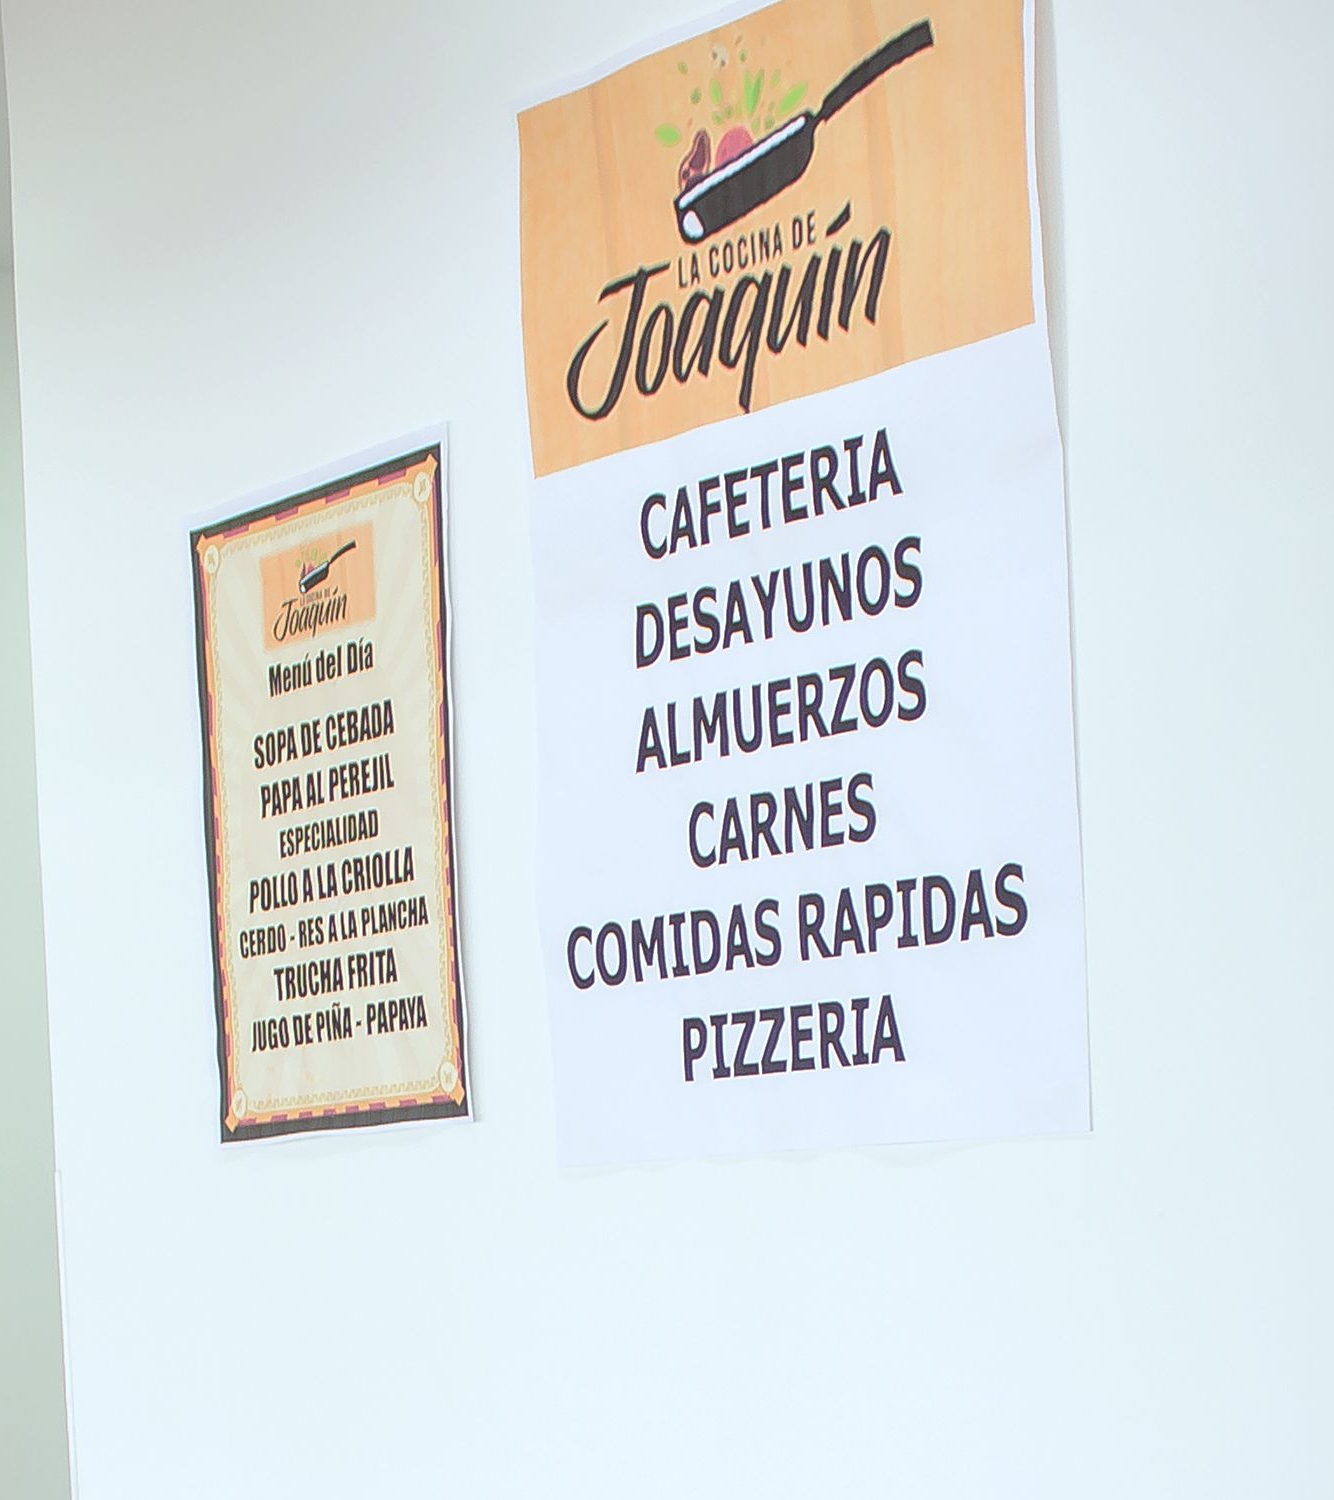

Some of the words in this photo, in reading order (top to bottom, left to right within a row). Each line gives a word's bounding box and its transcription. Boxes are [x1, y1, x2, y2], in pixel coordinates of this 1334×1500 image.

[678, 253, 701, 288] LA
[708, 223, 783, 278] COCINA
[792, 210, 816, 250] DE
[567, 200, 892, 420] Joaquín
[640, 427, 904, 560] CAFETERIA
[273, 586, 348, 642] Joaquín
[635, 536, 924, 668] DESAYUNOS
[268, 652, 312, 697] Menú
[315, 645, 342, 683] del
[346, 637, 373, 675] Día
[253, 726, 298, 769] SOPA
[300, 719, 322, 757] DE
[325, 698, 394, 750] CEBADA
[635, 649, 927, 773] ALMUERZOS
[260, 776, 303, 819] PAPA
[306, 770, 324, 807] AL
[329, 753, 395, 802] PEREJIL
[689, 772, 877, 868] CARNES
[279, 808, 379, 858] ESPECIALIDAD
[249, 871, 298, 914] POLLO
[302, 868, 314, 902] A
[317, 862, 338, 899] LA
[341, 846, 415, 895] CRIOLLA
[239, 923, 286, 959] CERDO
[299, 916, 325, 949] RES
[328, 913, 338, 943] A
[340, 909, 358, 941] LA
[361, 895, 429, 937] PLANCHA
[567, 898, 782, 990] COMIDAS
[799, 863, 1029, 962] RAPIDAS
[273, 957, 344, 1001] TRUCHA
[347, 947, 398, 990] FRITA
[252, 1016, 290, 1053] JUGO
[292, 1013, 314, 1046] DE
[317, 1001, 353, 1043] PIÑA
[366, 994, 428, 1035] PAPAYA
[683, 995, 906, 1082] PIZZERIA
